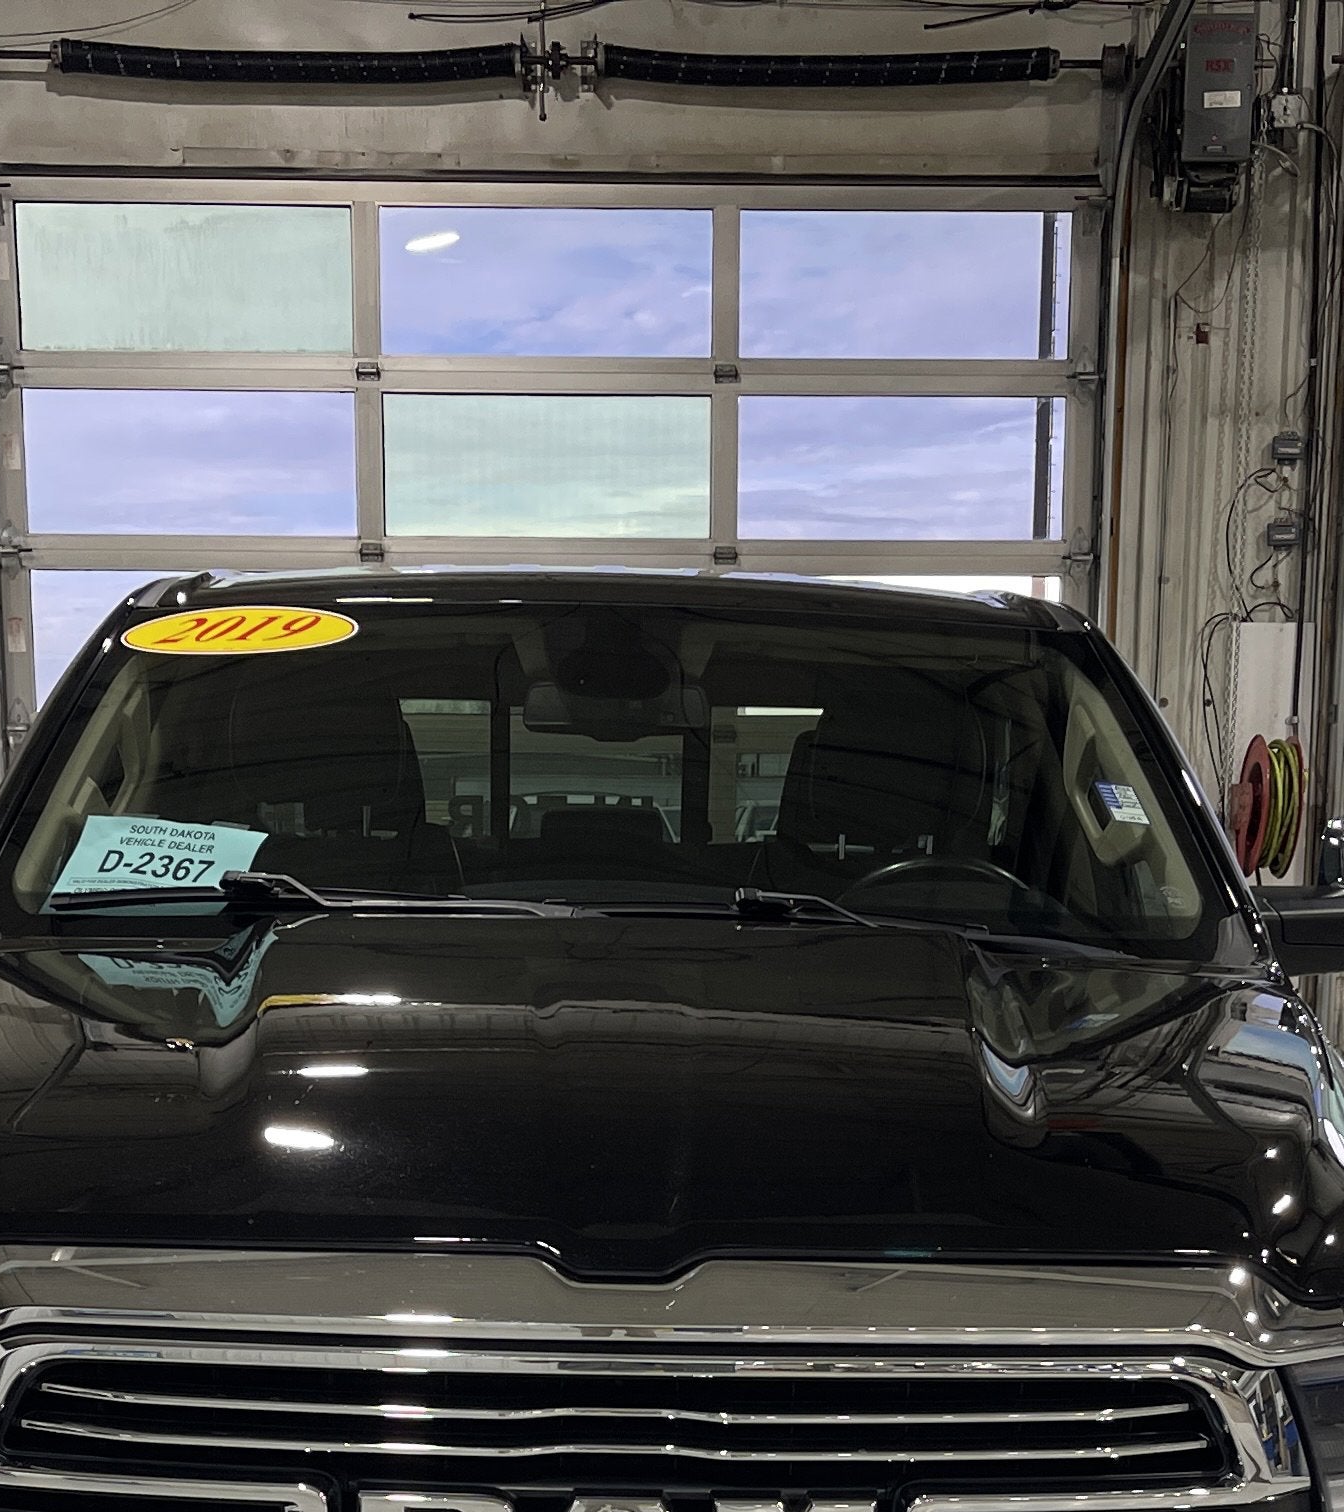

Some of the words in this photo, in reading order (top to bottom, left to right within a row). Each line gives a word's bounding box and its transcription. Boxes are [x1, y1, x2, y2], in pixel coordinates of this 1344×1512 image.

[152, 614, 322, 645] 2019
[129, 824, 167, 836] SOUTH
[170, 828, 216, 842] DAKOTA
[119, 837, 166, 848] VEHICLE
[167, 840, 215, 854] DEALER
[97, 849, 215, 883] D-2367
